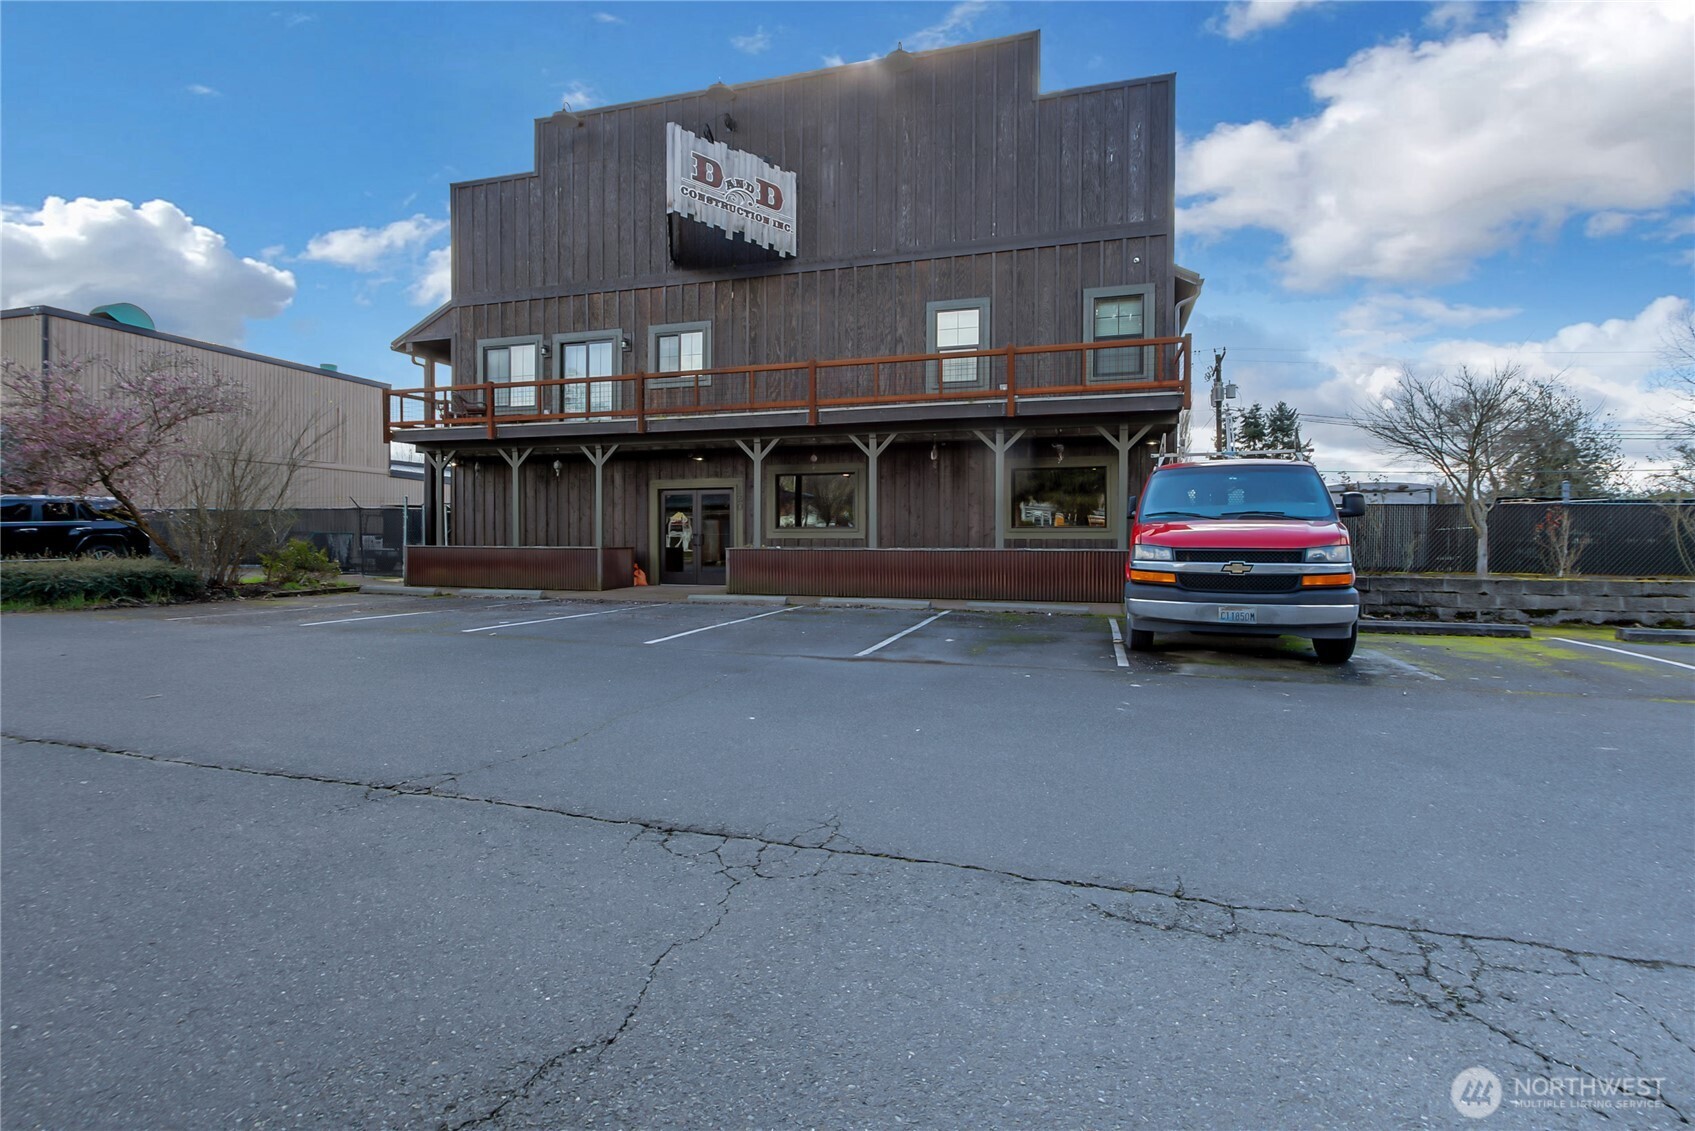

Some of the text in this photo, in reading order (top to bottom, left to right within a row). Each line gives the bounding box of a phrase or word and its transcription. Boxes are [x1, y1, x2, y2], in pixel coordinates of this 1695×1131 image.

[680, 186, 770, 225] CONSTRUCTION
[691, 151, 784, 211] D AND D
